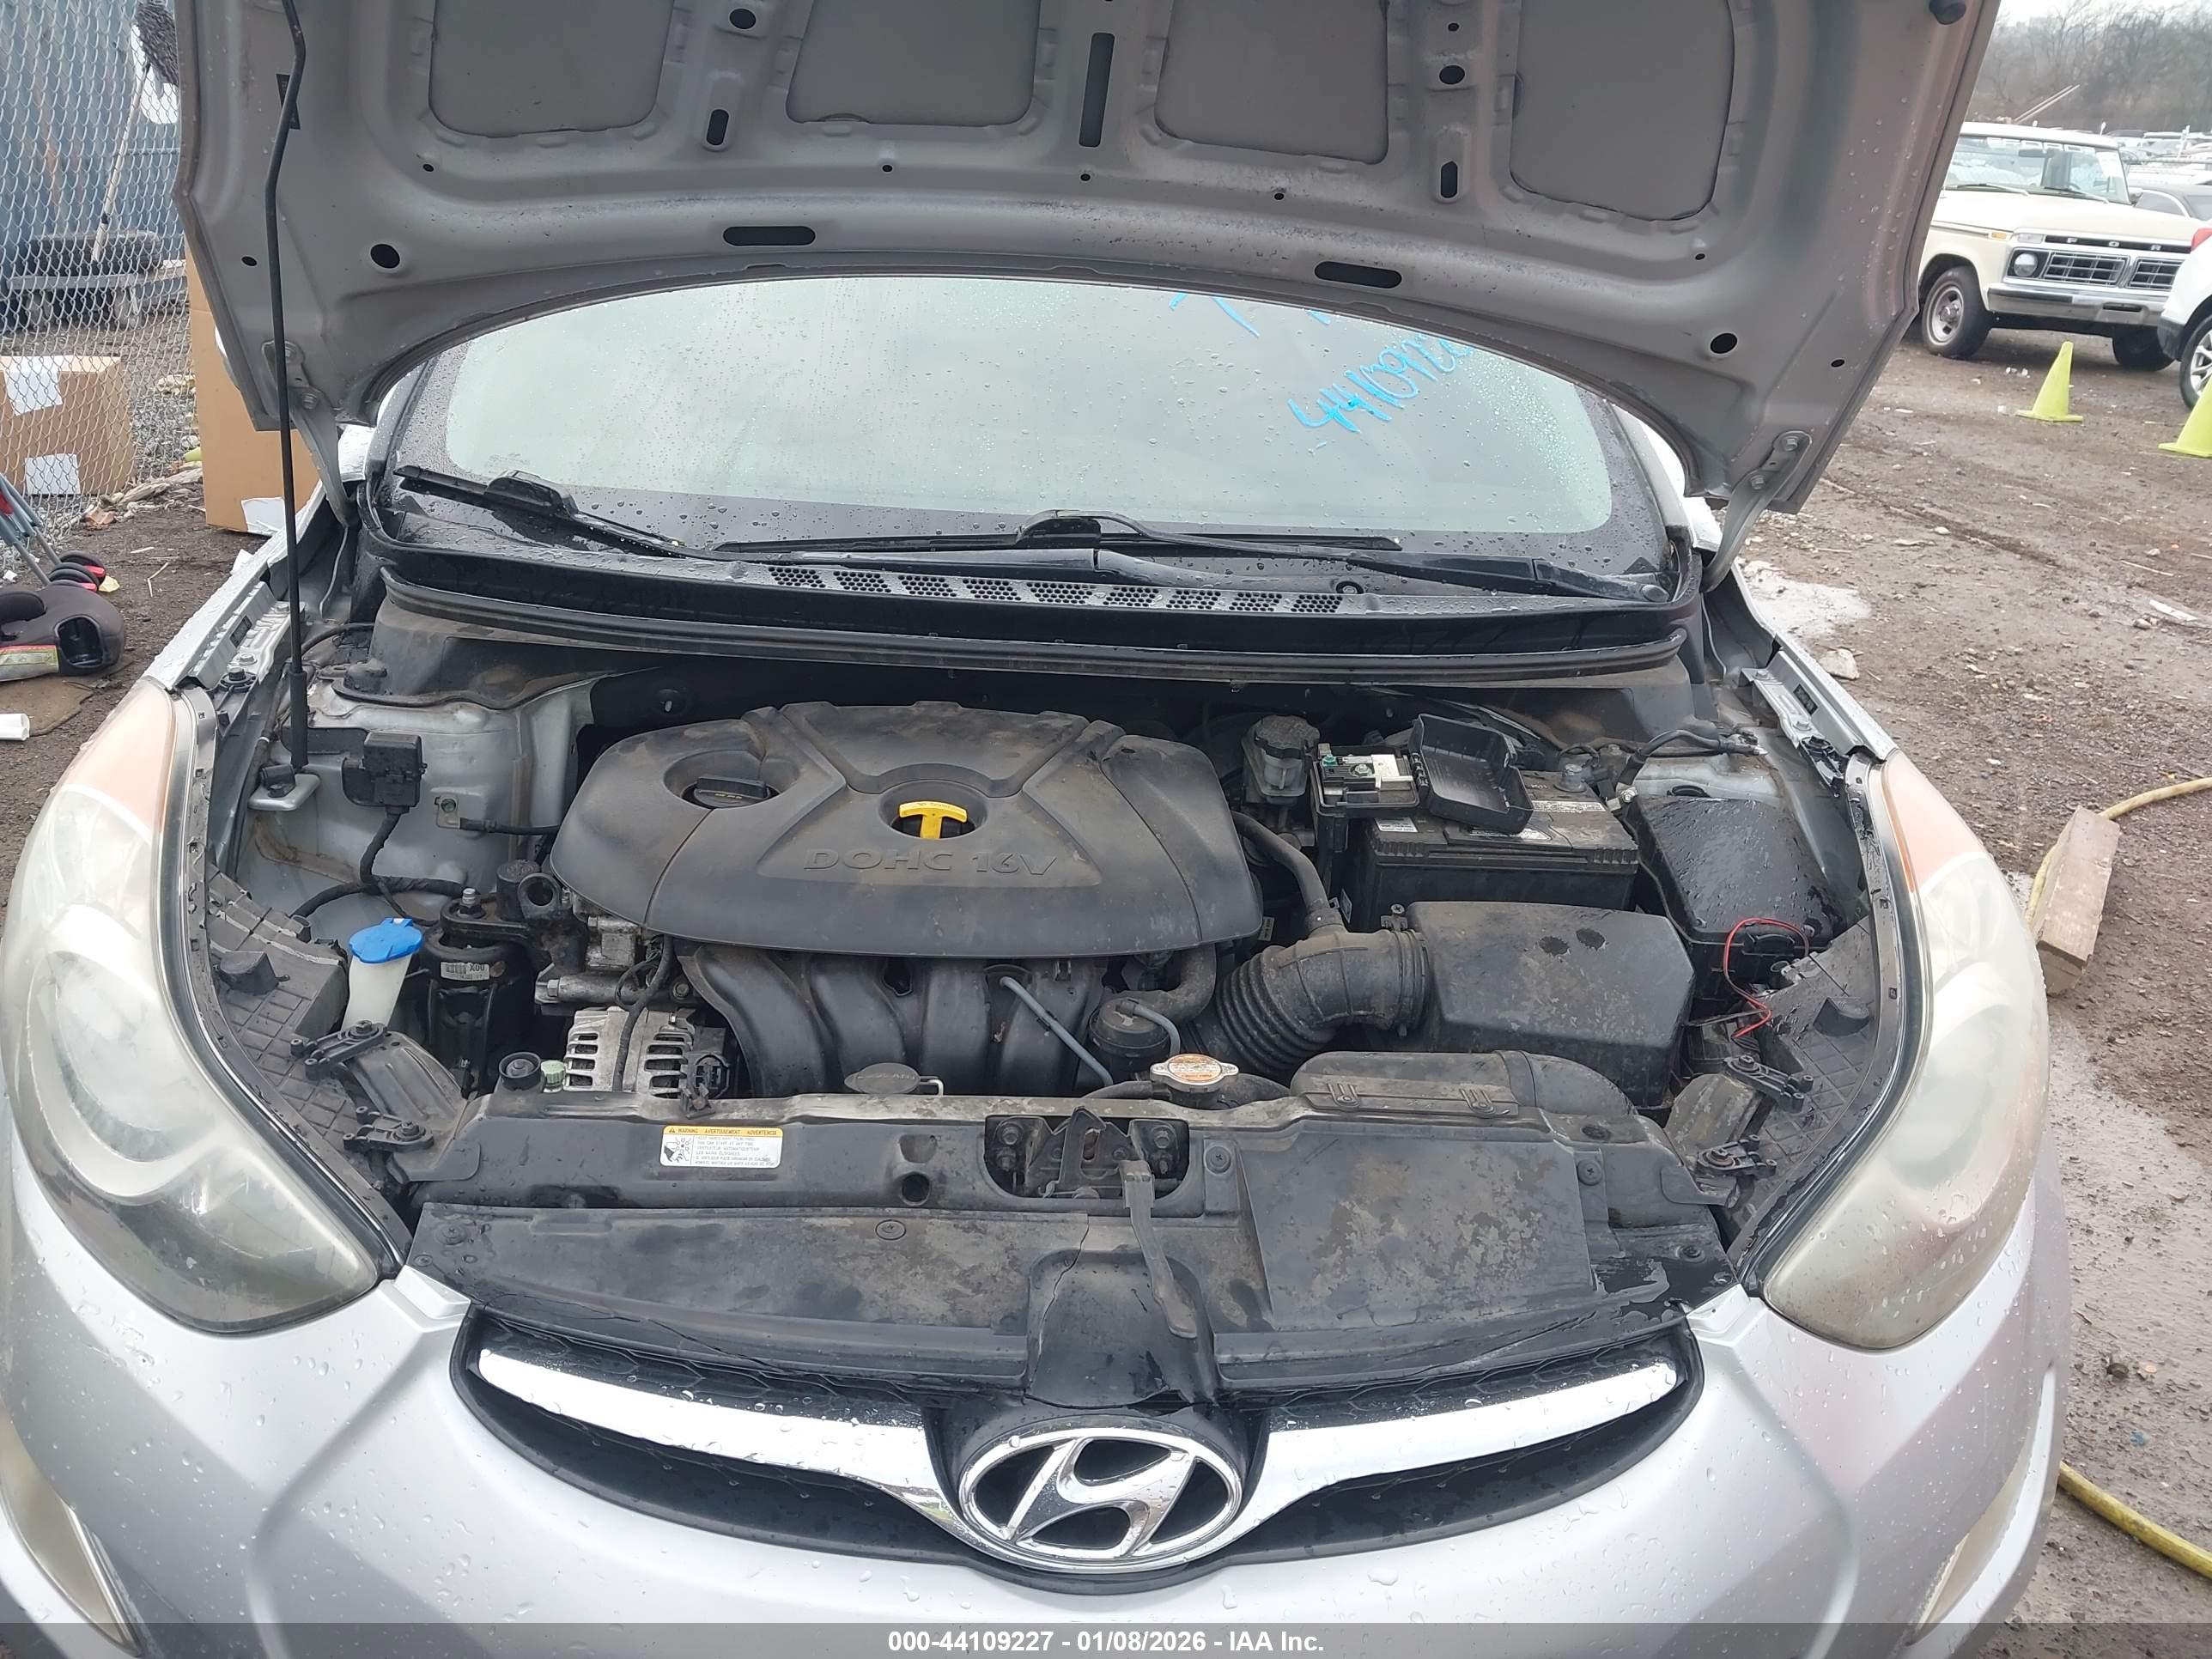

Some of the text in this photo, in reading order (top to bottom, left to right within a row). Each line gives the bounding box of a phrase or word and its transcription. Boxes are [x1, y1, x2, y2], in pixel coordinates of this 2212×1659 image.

[2066, 237, 2162, 252] FOR
[803, 848, 1058, 876] DOHC 16V
